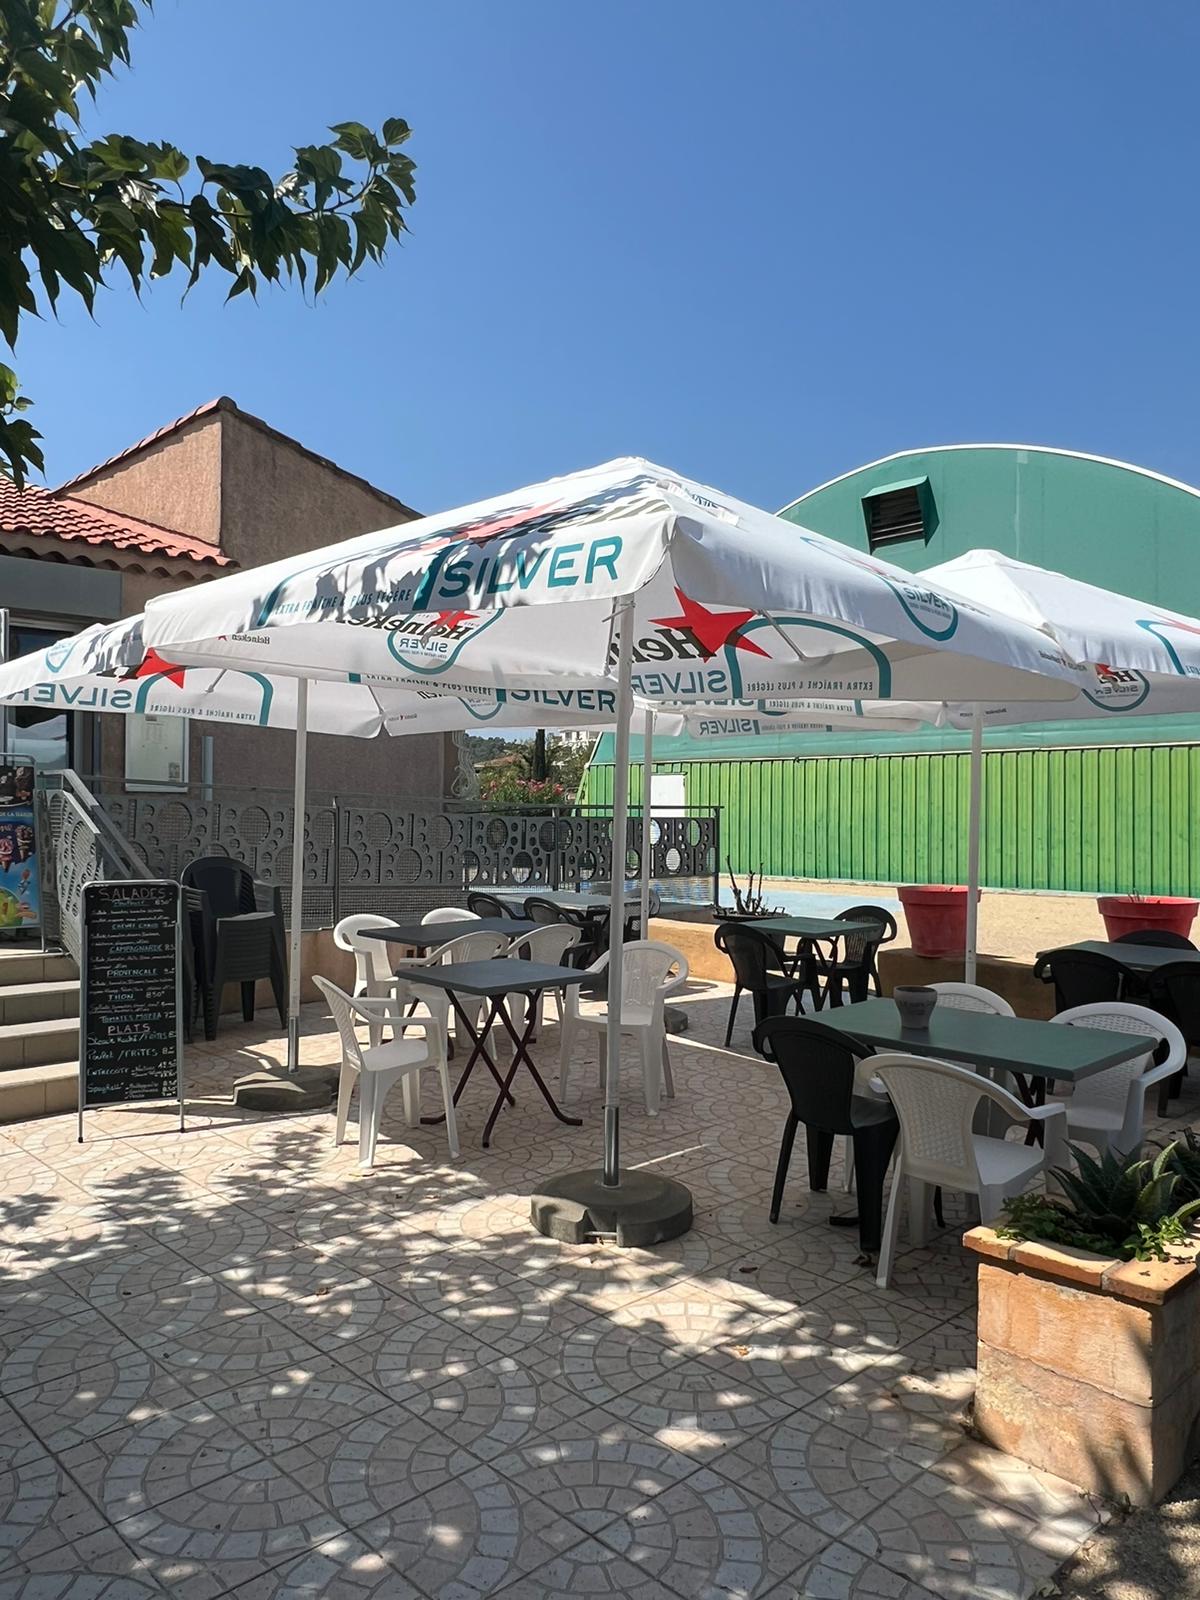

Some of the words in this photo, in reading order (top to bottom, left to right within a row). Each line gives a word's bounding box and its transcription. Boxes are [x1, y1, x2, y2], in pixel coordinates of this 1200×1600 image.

[439, 535, 623, 598] SILVER
[350, 593, 373, 607] PLUS
[511, 689, 617, 713] SILVER
[98, 888, 166, 899] SALADES
[107, 1023, 151, 1035] PLATS
